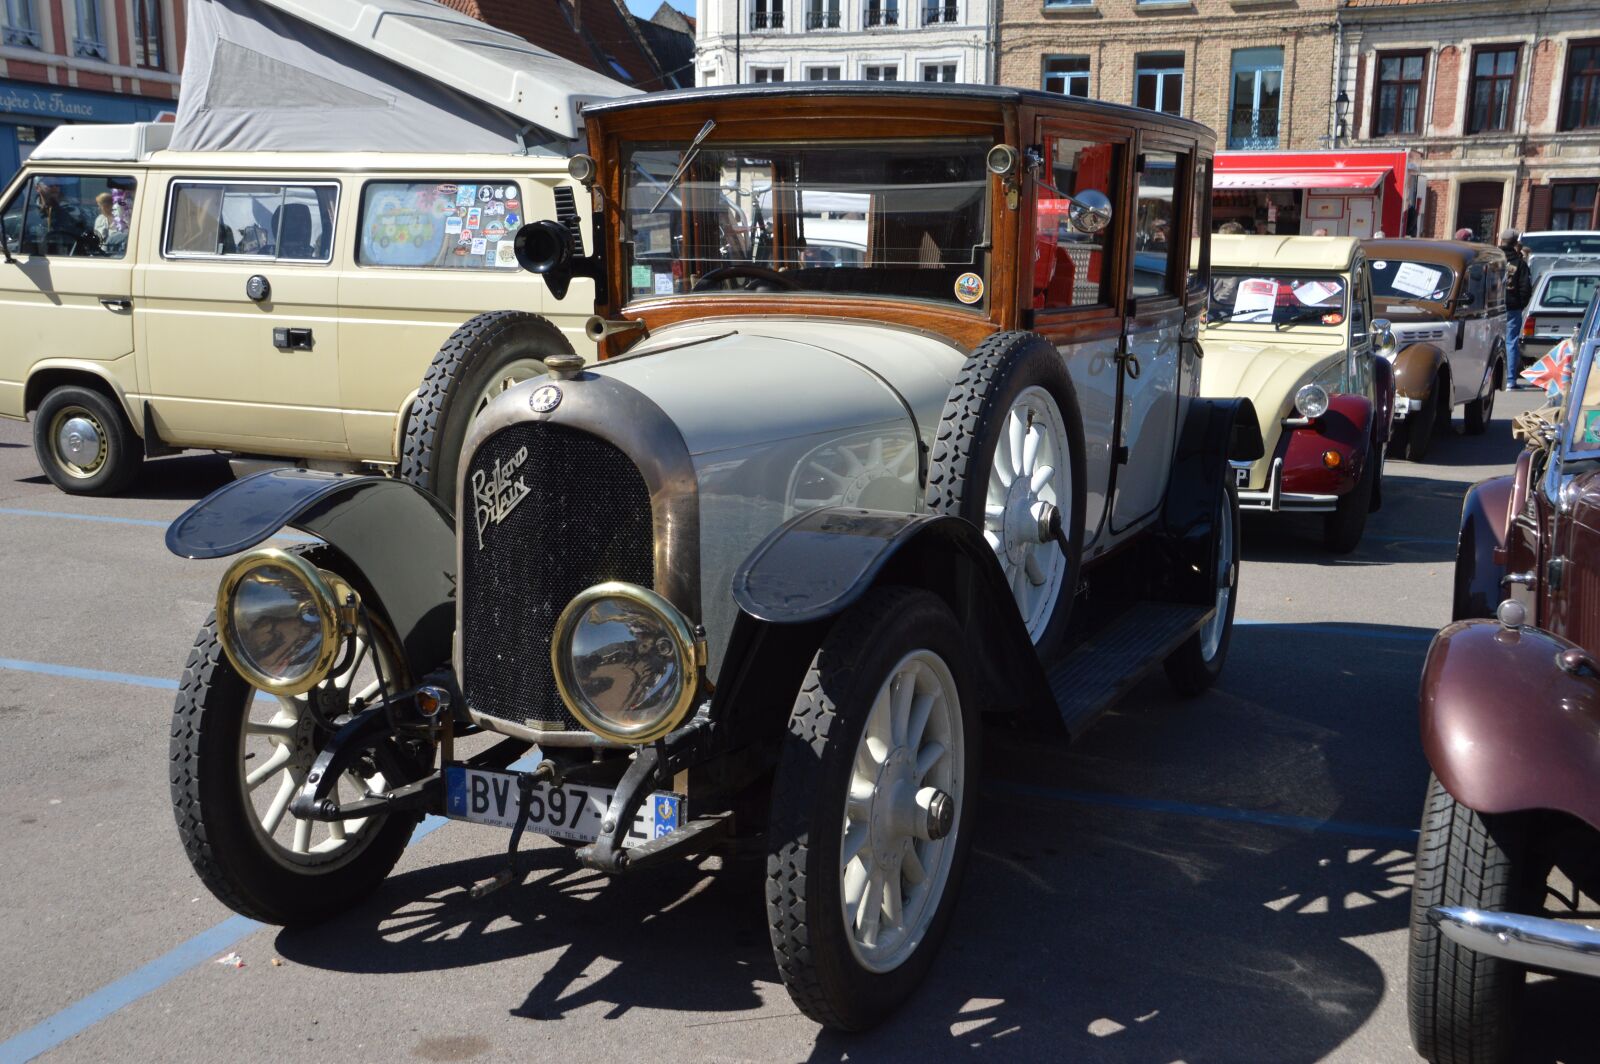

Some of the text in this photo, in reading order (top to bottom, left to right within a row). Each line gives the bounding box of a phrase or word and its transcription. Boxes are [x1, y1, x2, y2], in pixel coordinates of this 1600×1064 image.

[33, 93, 46, 111] de
[49, 93, 93, 116] France
[454, 796, 460, 807] F
